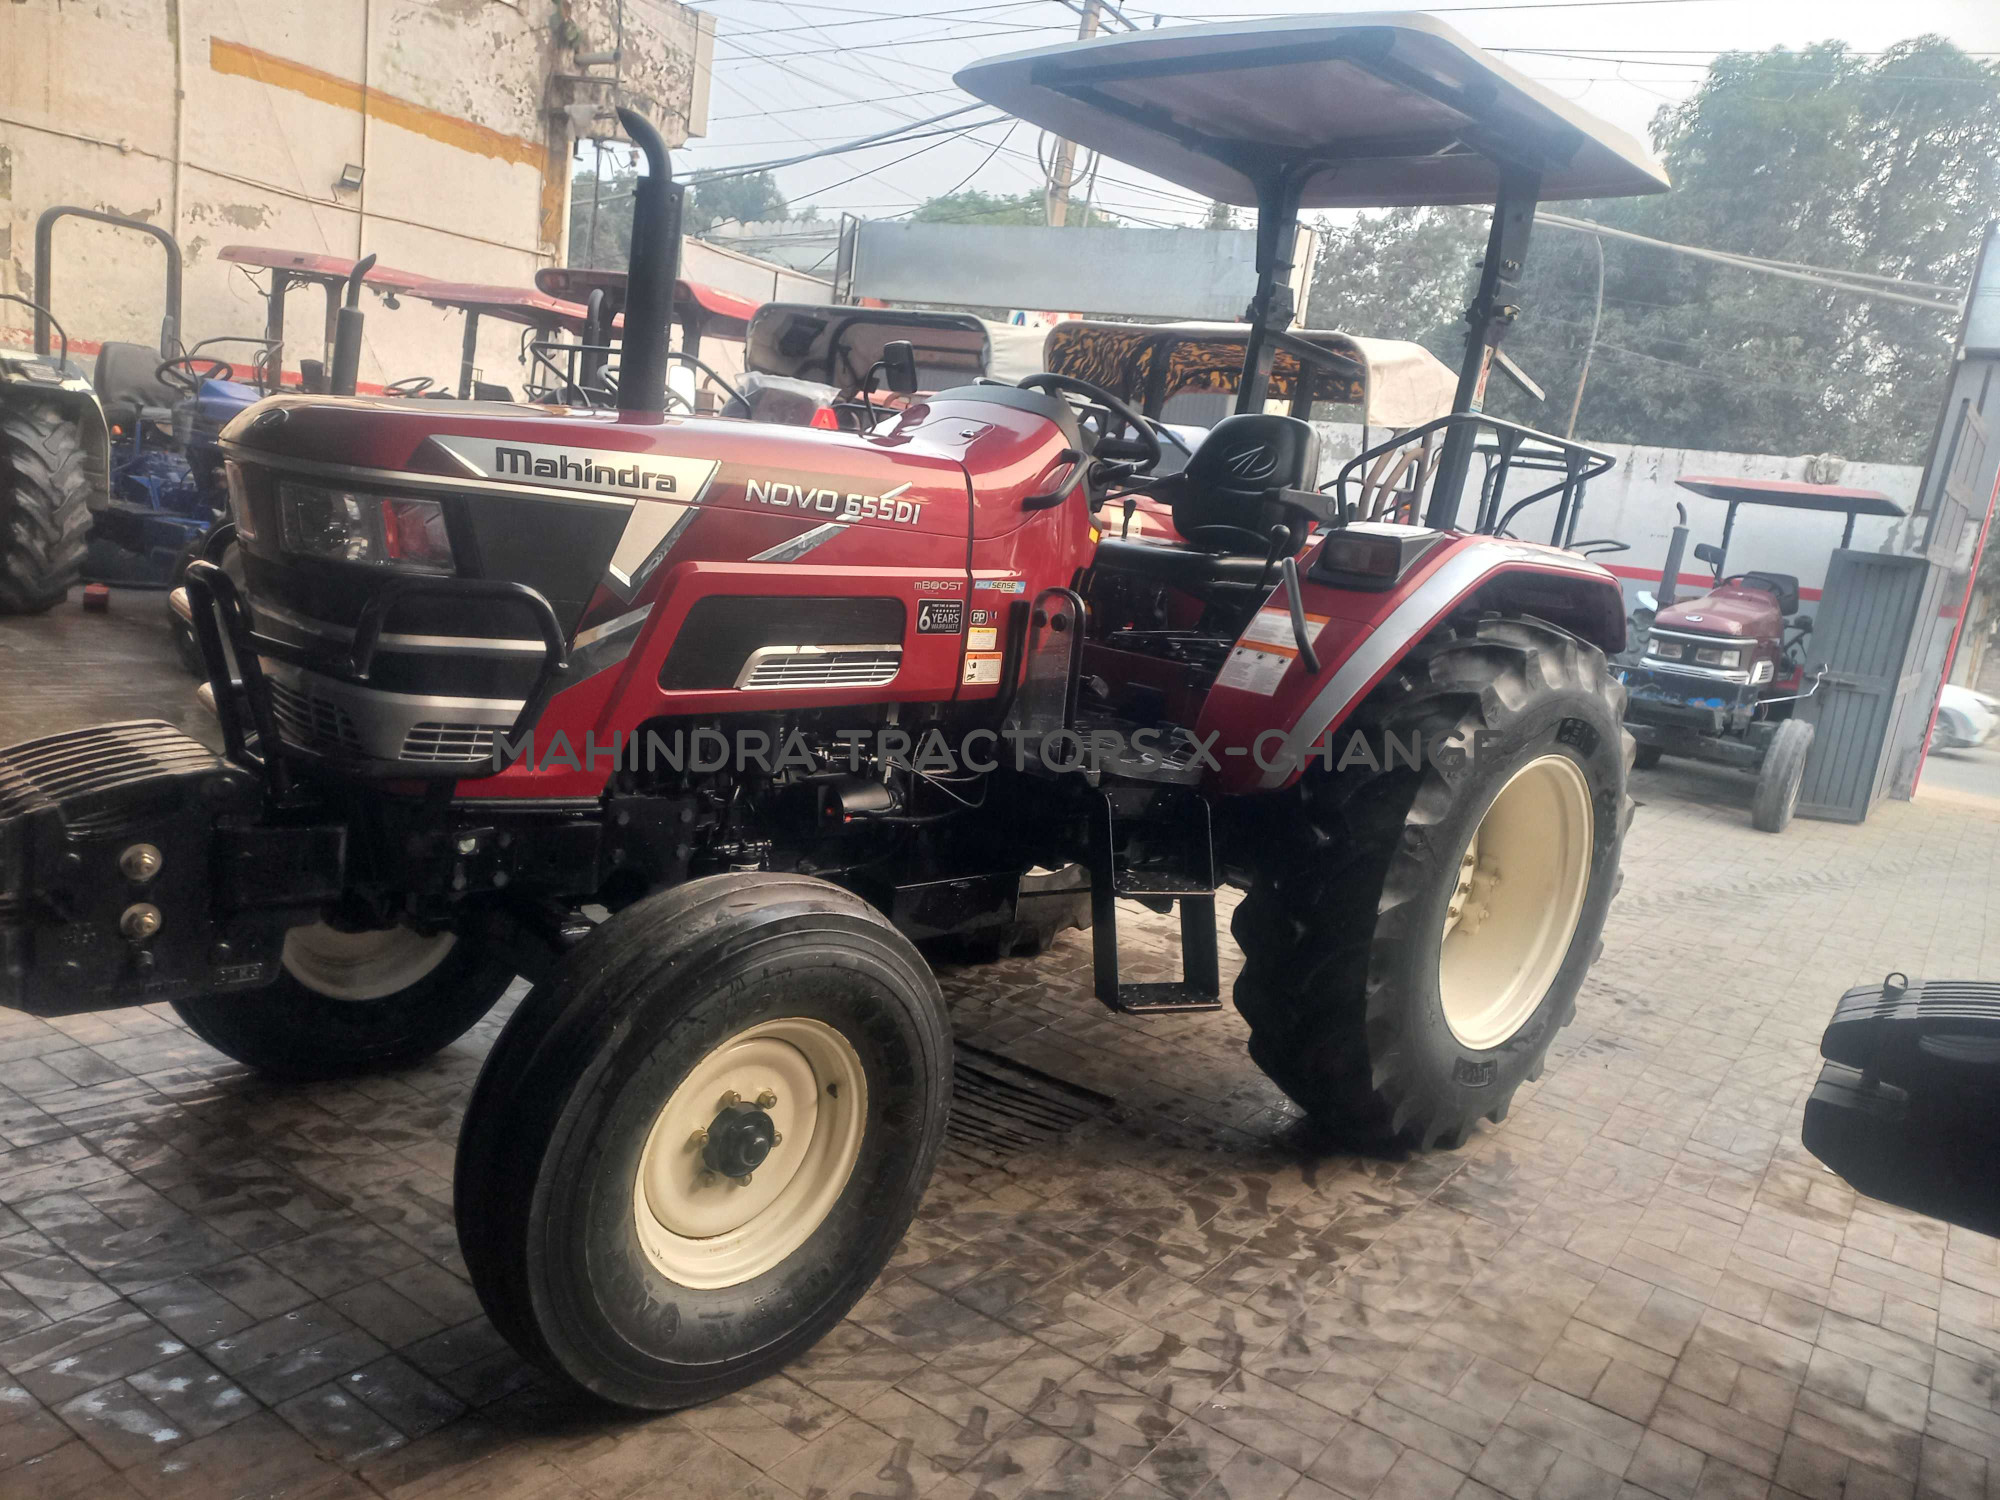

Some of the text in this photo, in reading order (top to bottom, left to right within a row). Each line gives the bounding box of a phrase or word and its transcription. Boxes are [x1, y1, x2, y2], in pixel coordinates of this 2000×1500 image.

[495, 446, 677, 493] Mahindra
[745, 479, 921, 525] NOVO 655DI
[918, 605, 960, 631] 6 YEARS
